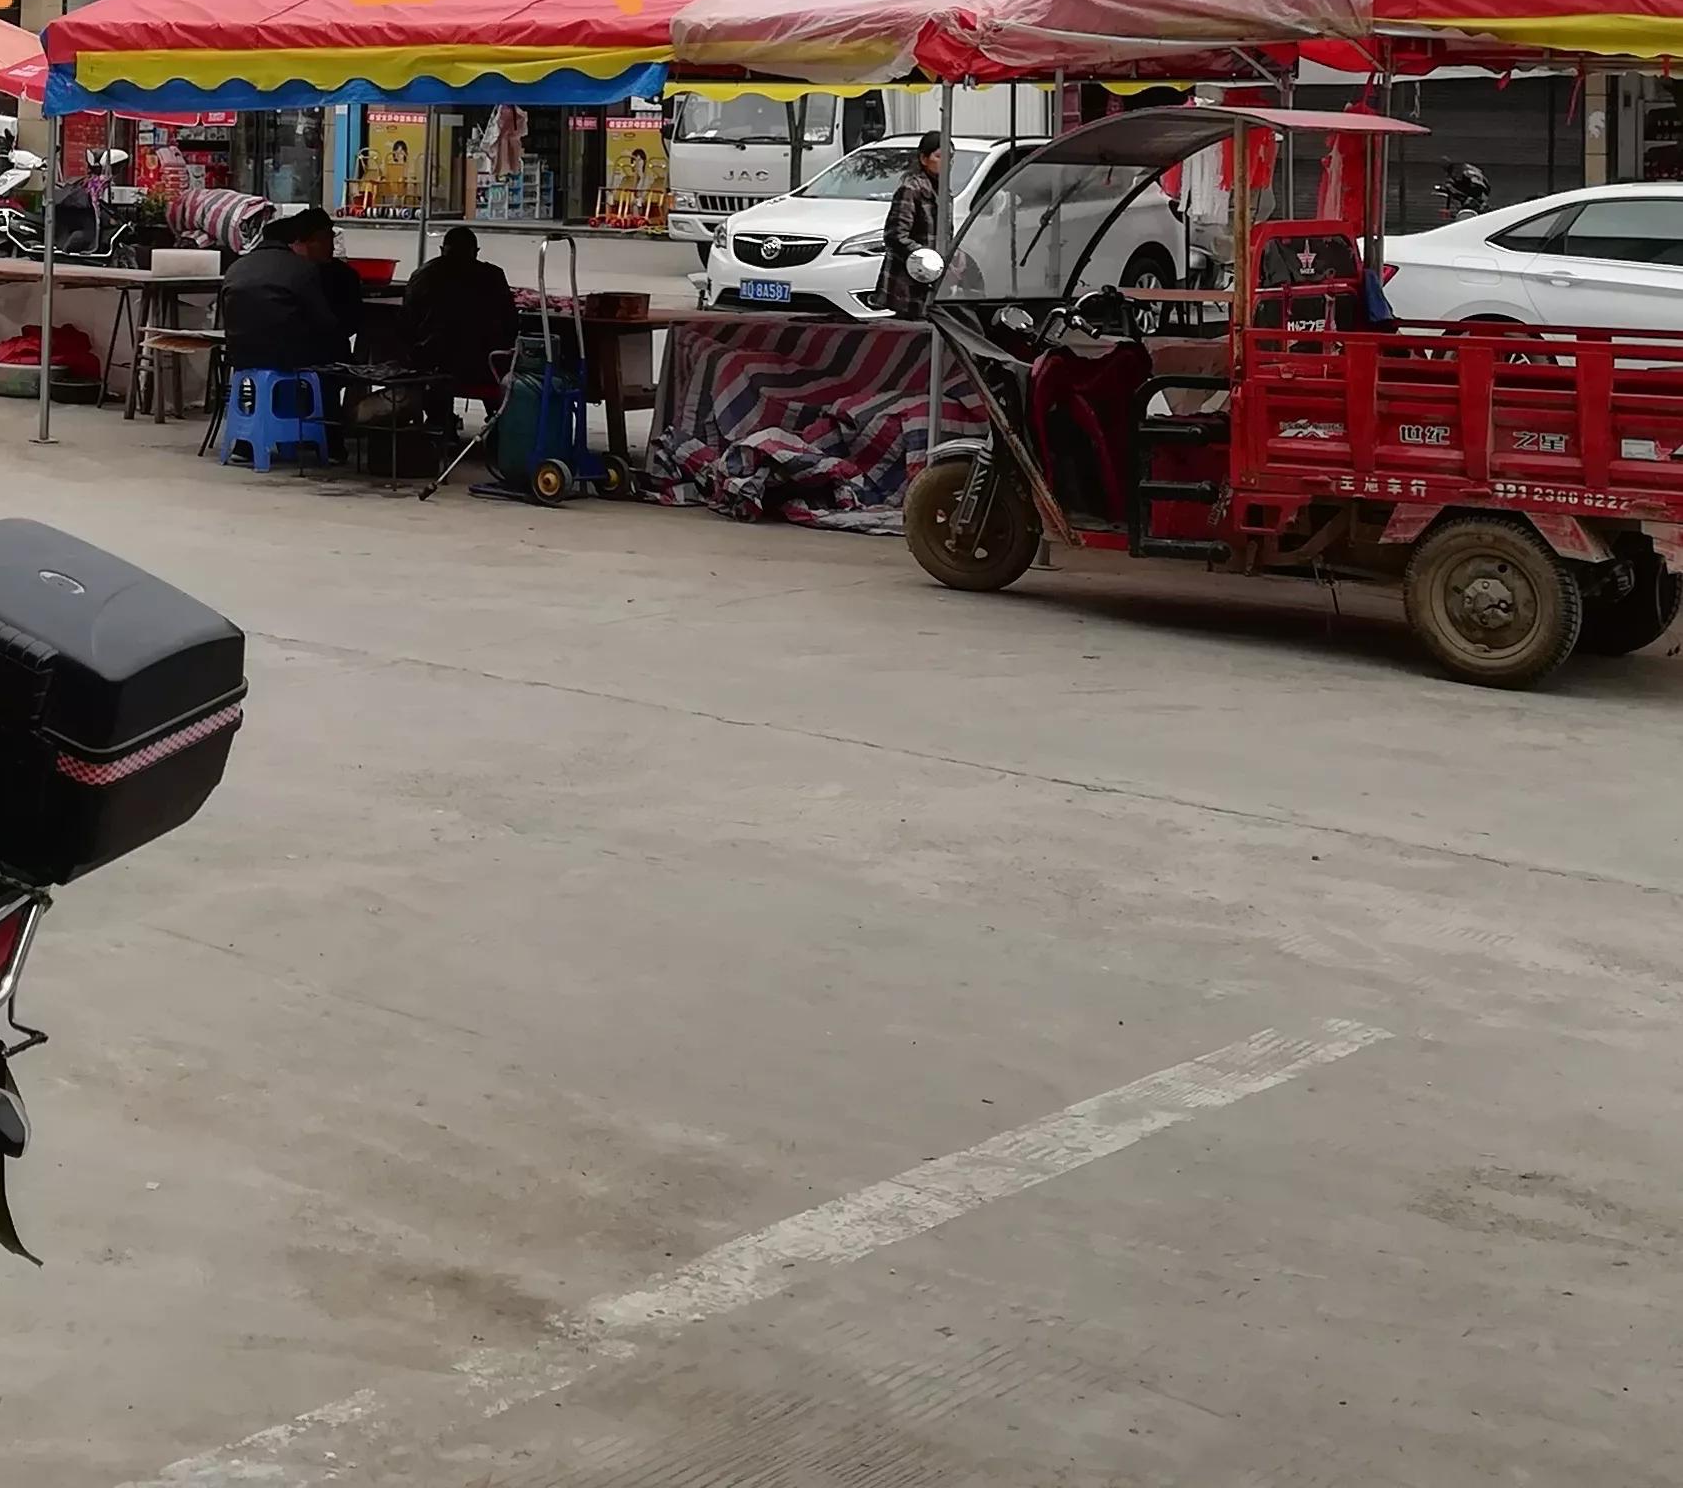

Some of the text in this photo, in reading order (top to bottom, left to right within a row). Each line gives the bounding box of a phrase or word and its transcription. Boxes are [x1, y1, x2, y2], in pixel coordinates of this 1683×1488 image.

[722, 169, 770, 182] JAC
[1399, 424, 1569, 453] 世纪 之星
